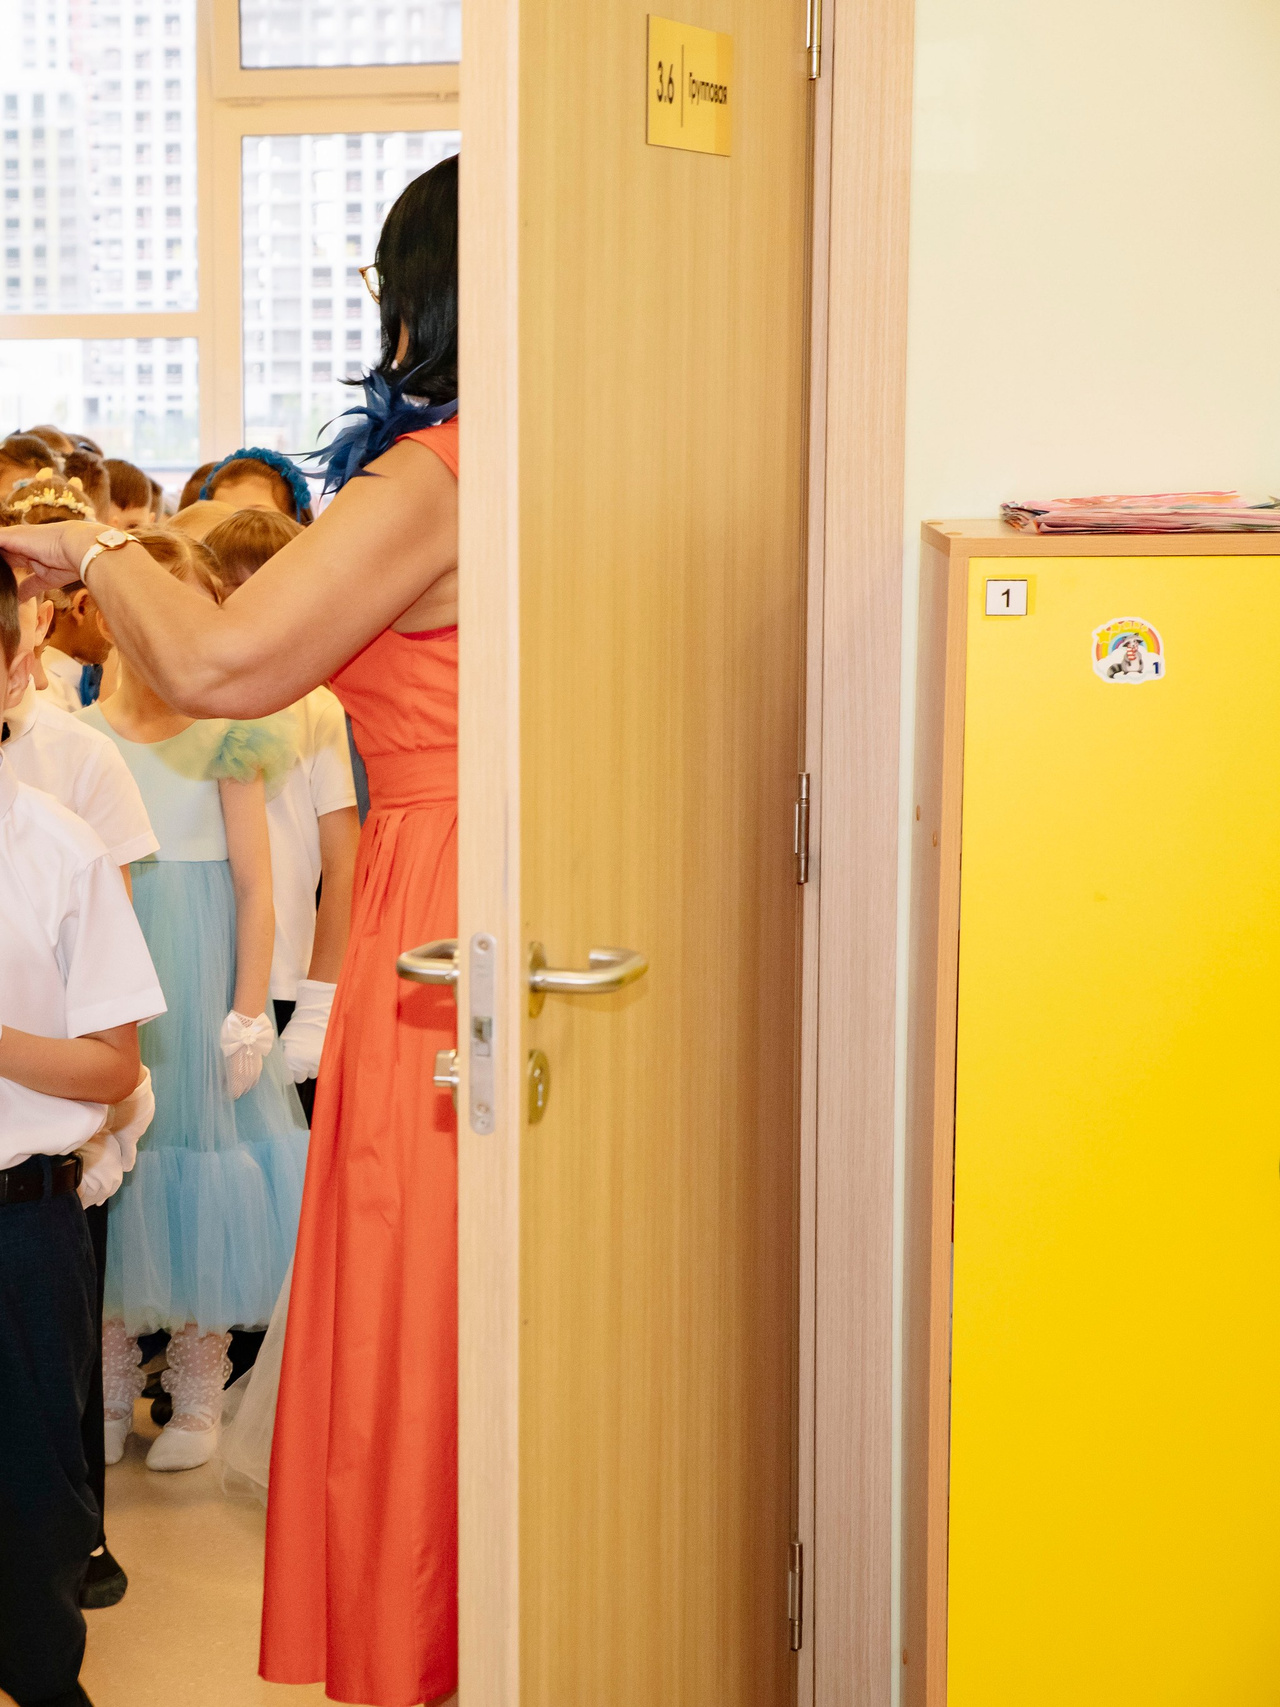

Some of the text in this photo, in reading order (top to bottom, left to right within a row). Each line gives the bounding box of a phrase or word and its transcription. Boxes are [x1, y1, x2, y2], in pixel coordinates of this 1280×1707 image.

[656, 60, 728, 106] 3.6 Групповая
[1001, 588, 1011, 608] 1
[1152, 661, 1160, 675] 1
